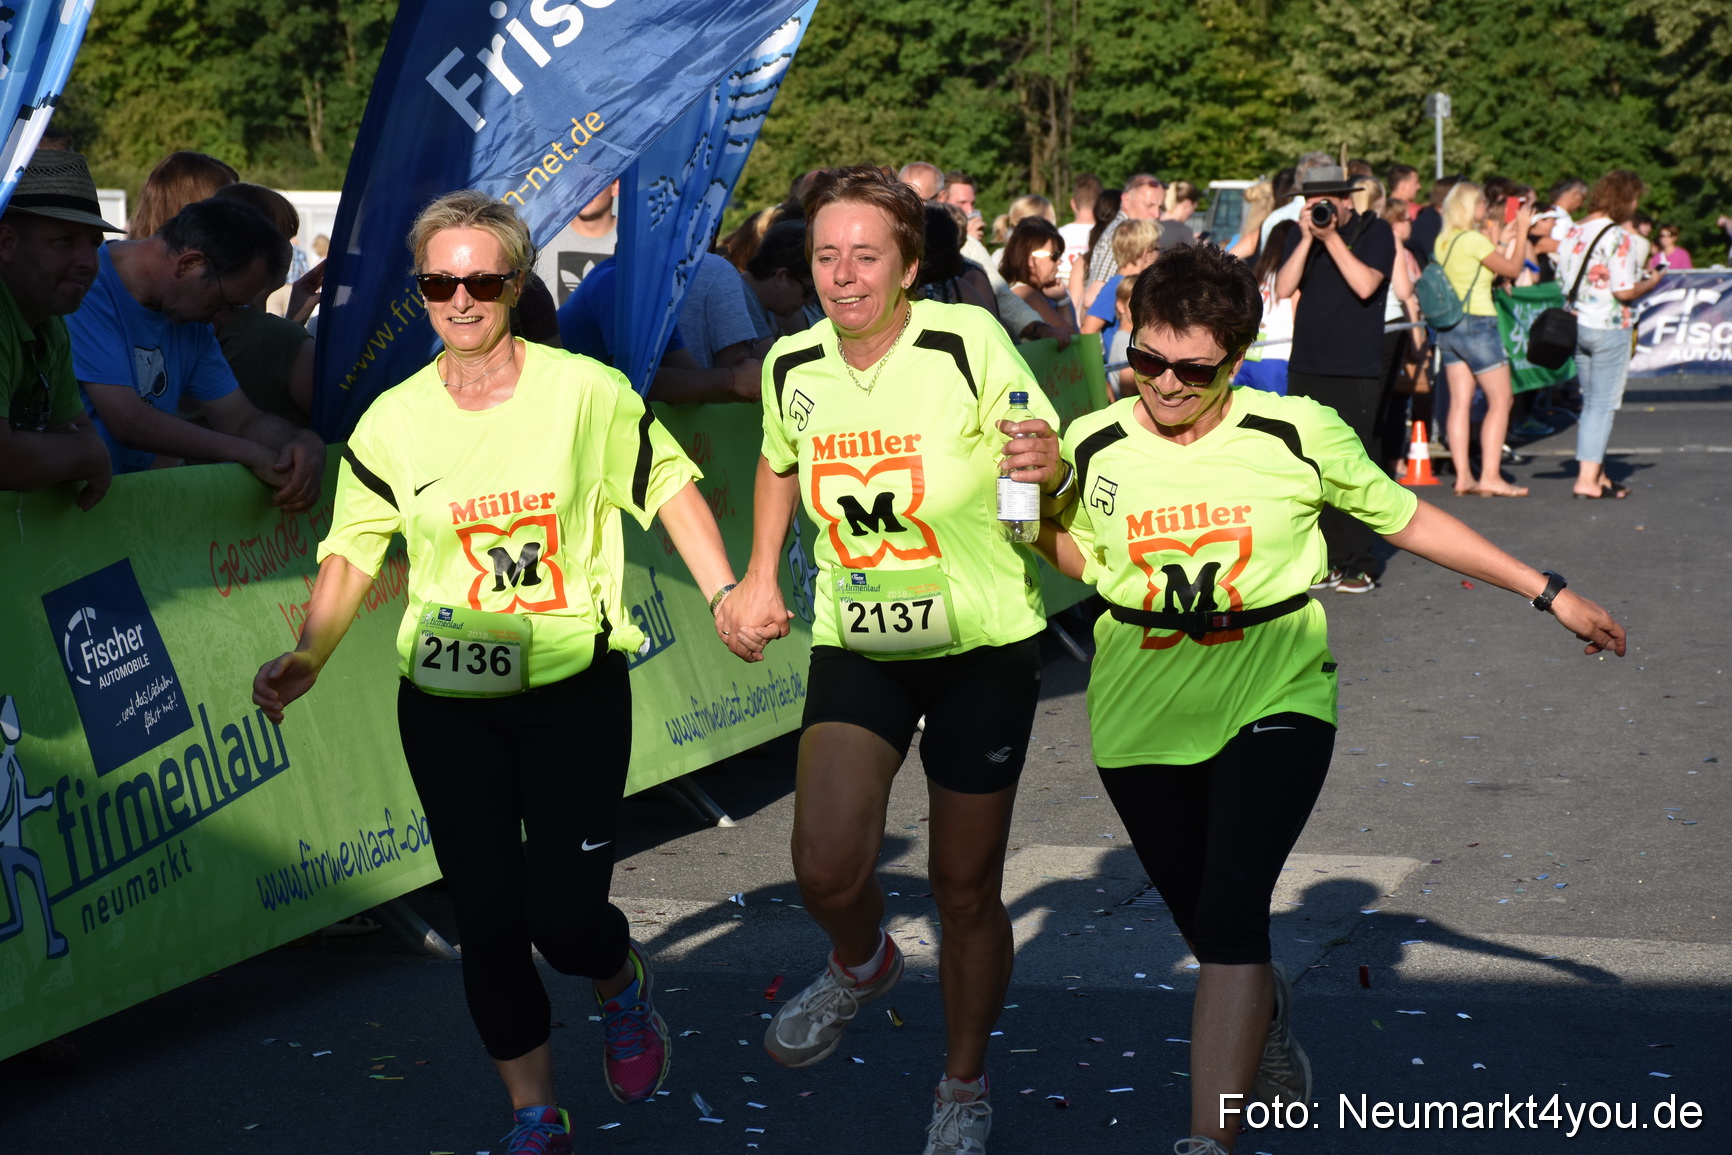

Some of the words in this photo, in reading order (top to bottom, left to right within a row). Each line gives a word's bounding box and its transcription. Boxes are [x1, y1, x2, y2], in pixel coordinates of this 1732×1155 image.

[500, 111, 605, 206] n-net.de
[1651, 315, 1732, 345] Fisc
[811, 429, 922, 462] Müller
[448, 490, 556, 525] Müller
[836, 491, 908, 537] M
[1125, 501, 1252, 541] Müller
[487, 541, 542, 592] M
[1160, 561, 1222, 614] M
[847, 598, 934, 634] 2137
[80, 623, 145, 674] Fischer
[421, 636, 512, 677] 2136
[98, 653, 150, 690] AUTOMOBILE
[256, 807, 432, 912] www.firmenlauf-ob
[81, 839, 193, 935] neumarkt
